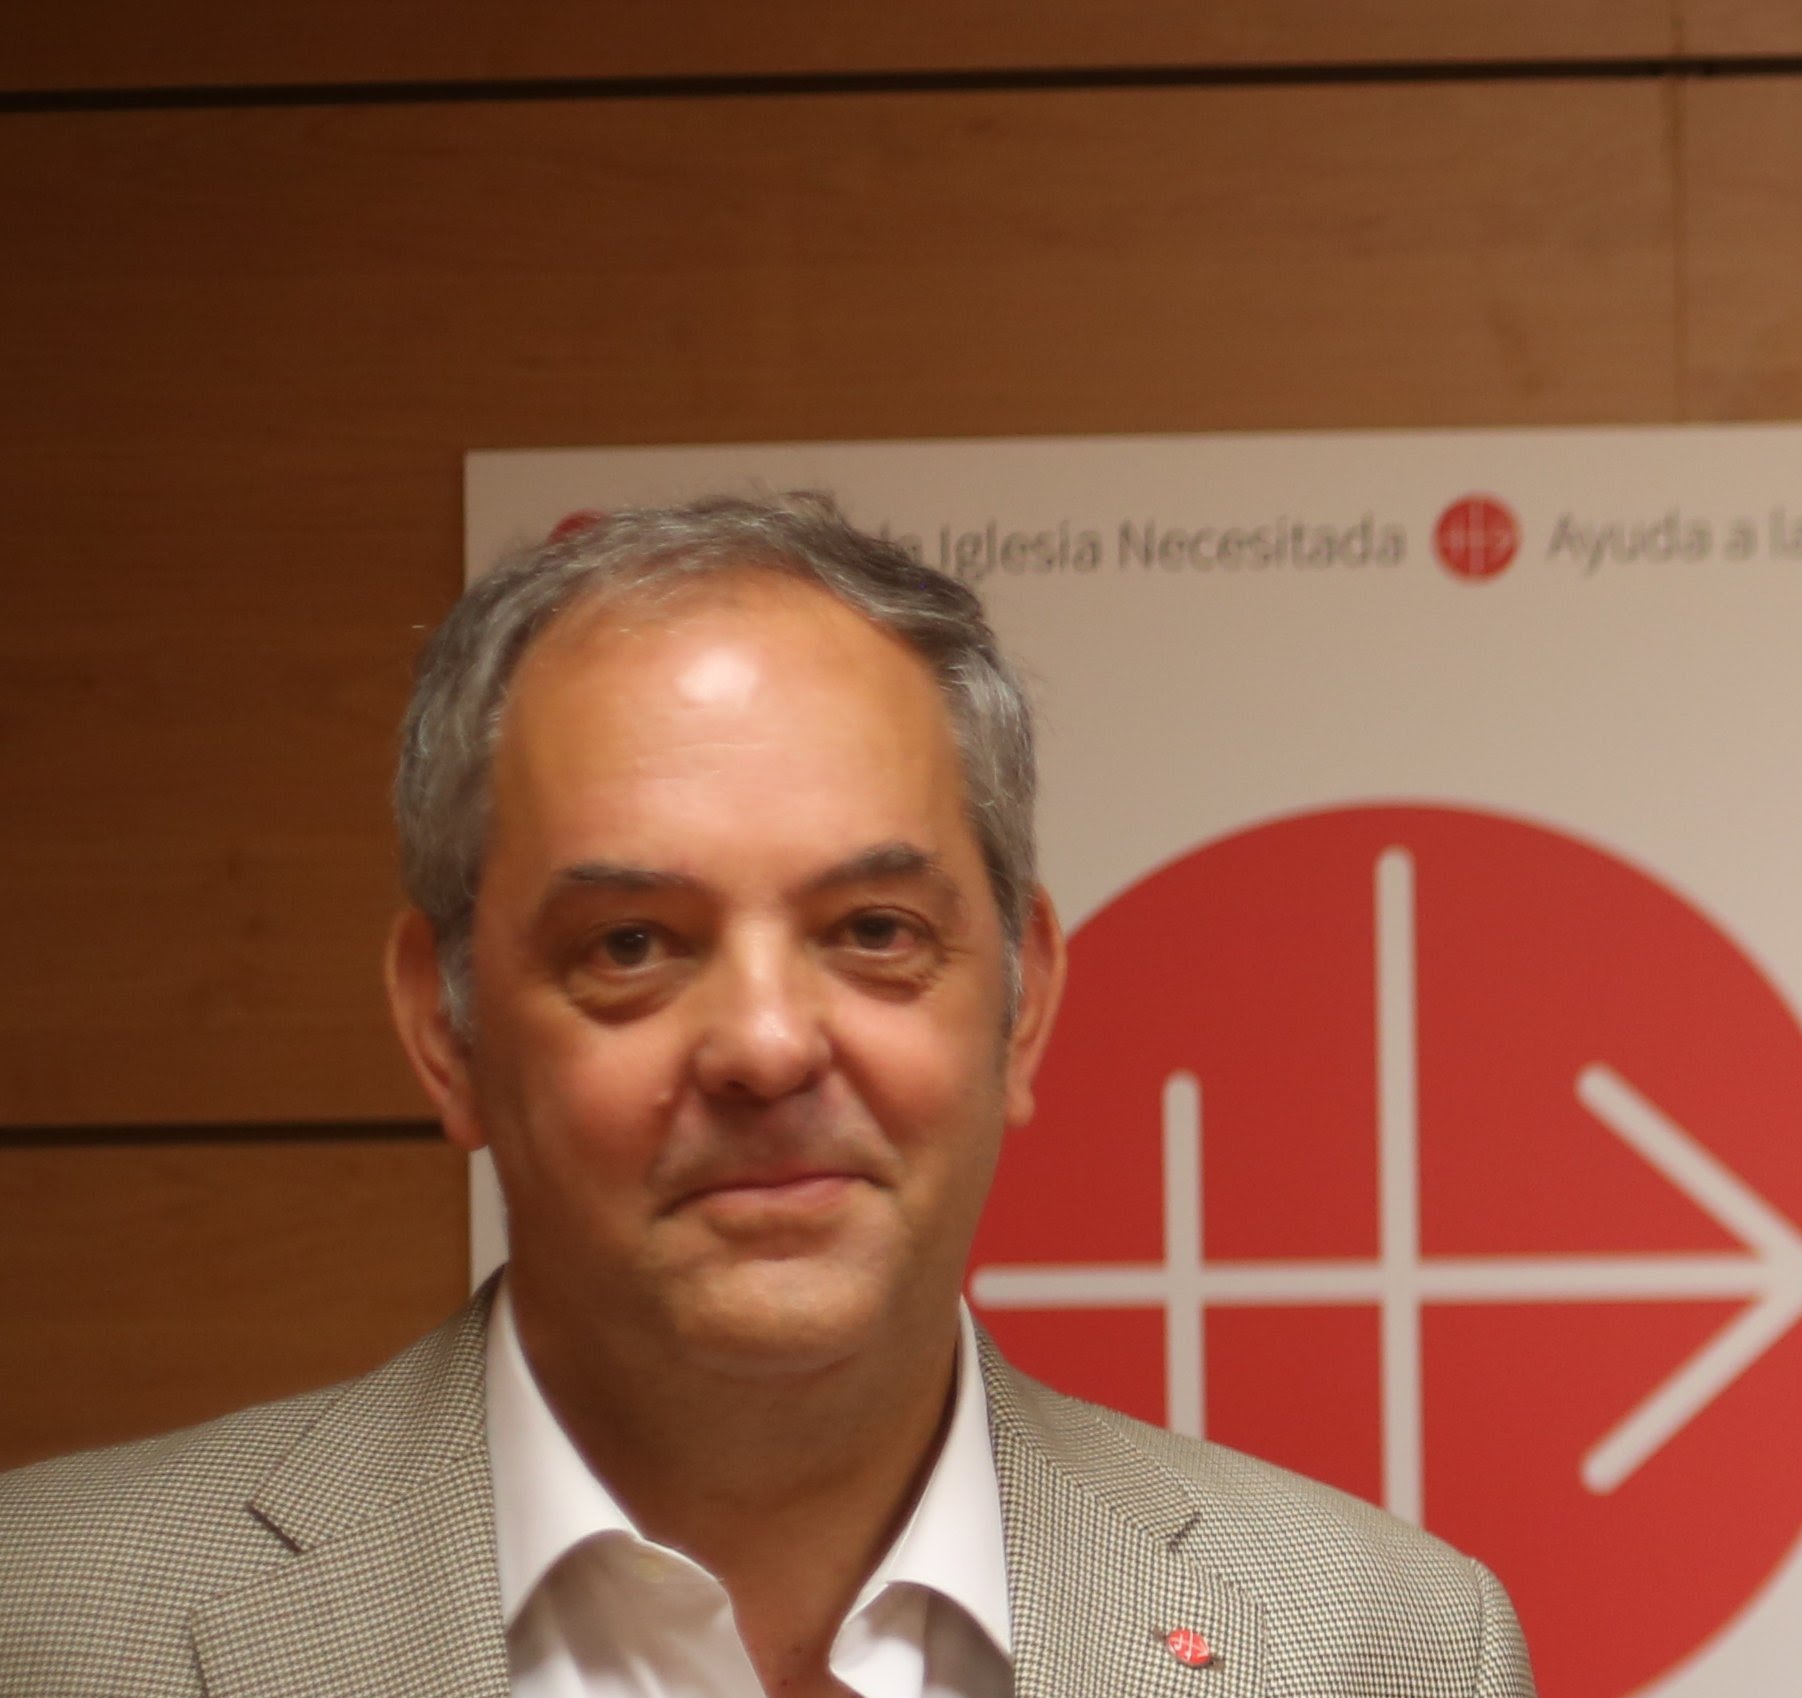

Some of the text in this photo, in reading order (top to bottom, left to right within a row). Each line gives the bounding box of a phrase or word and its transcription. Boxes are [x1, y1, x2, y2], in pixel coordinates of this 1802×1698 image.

[938, 514, 1103, 580] Iglesia
[1117, 509, 1409, 574] Necesitada
[1545, 505, 1715, 577] Ayuda
[1722, 518, 1759, 562] a
